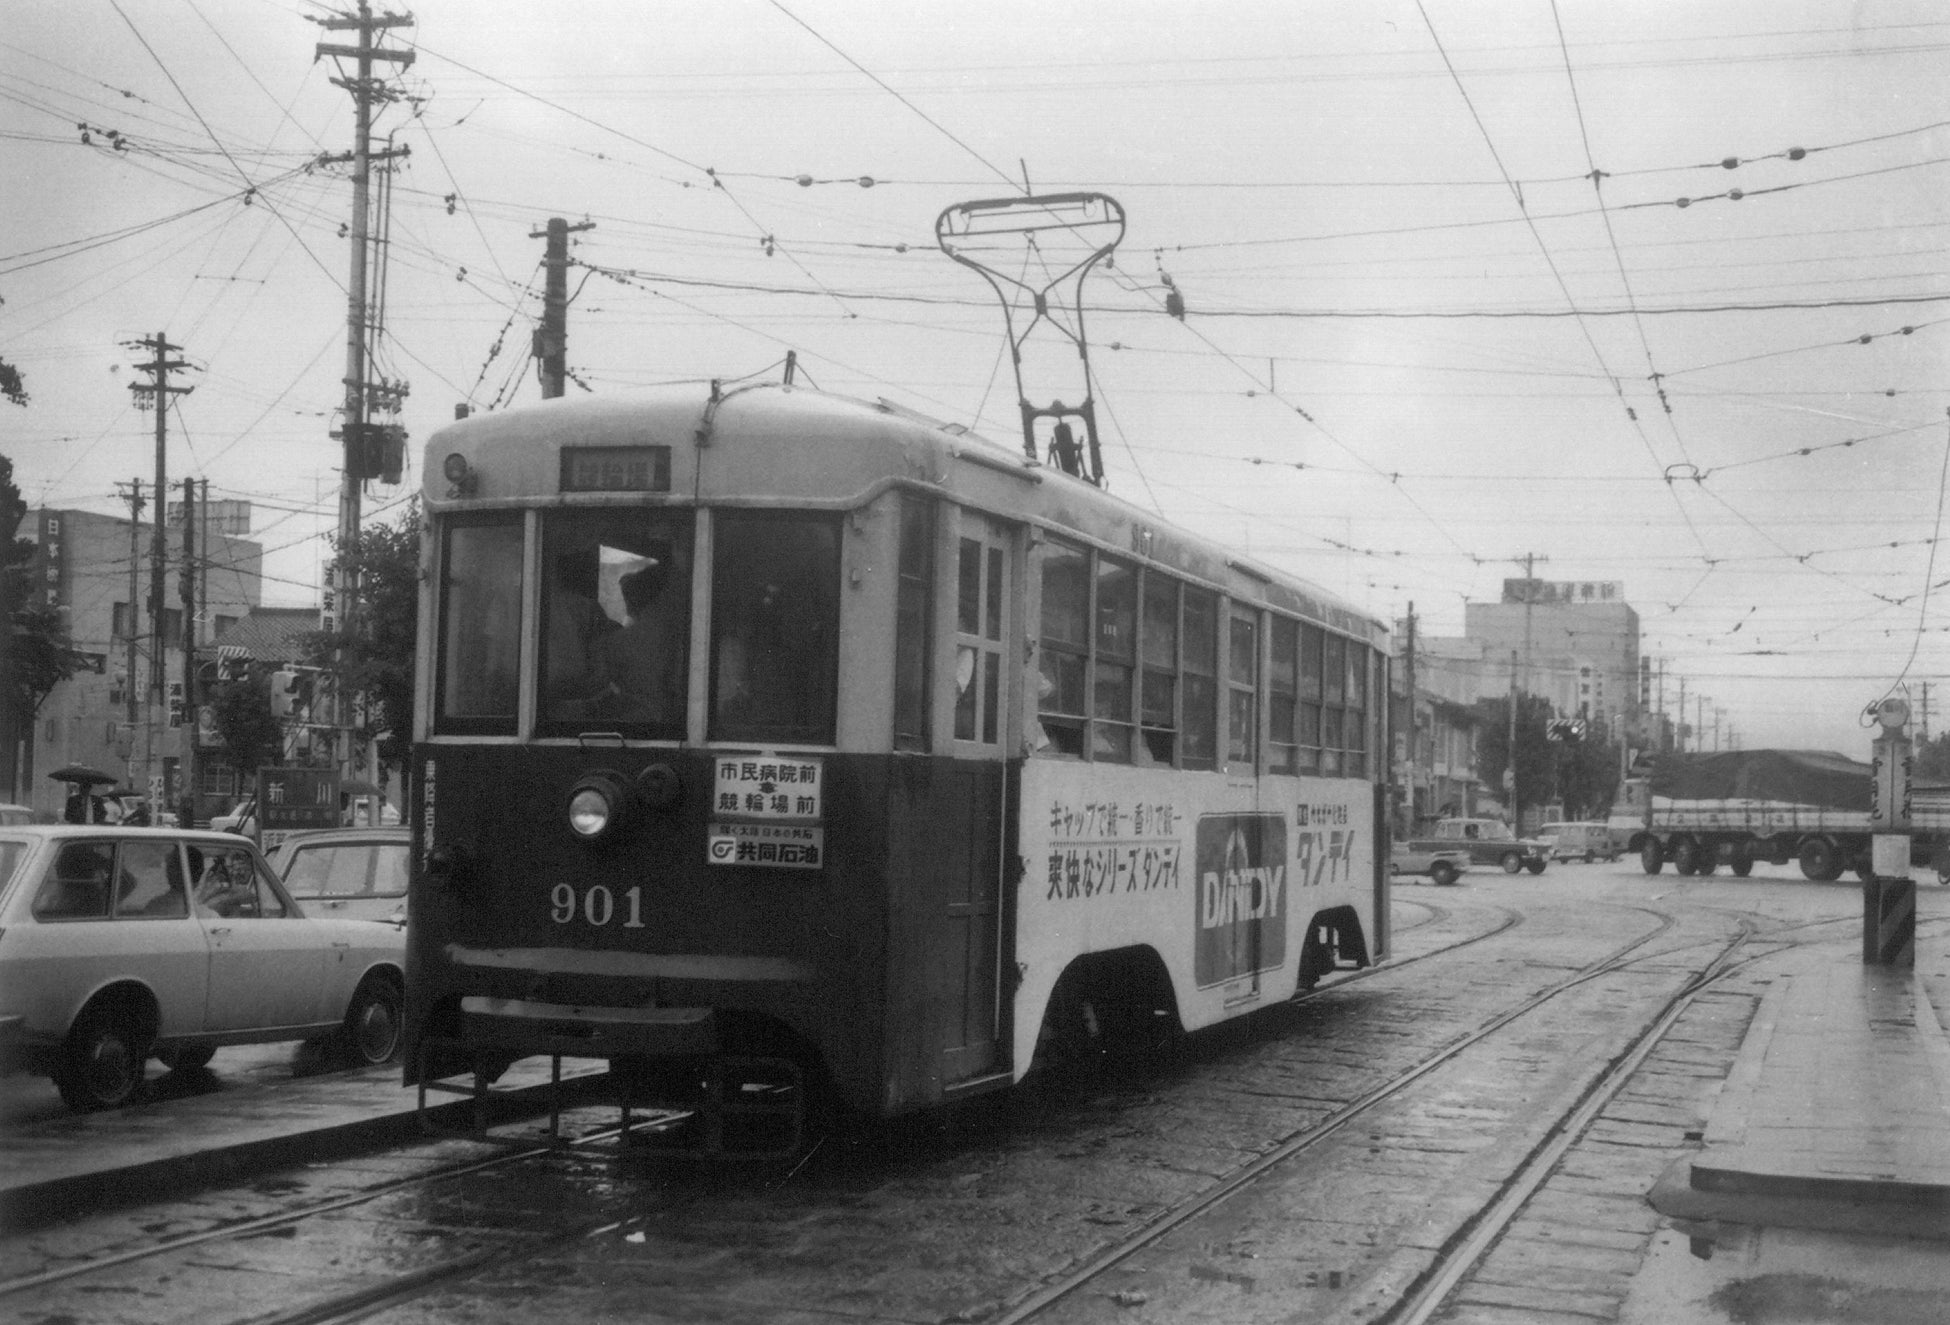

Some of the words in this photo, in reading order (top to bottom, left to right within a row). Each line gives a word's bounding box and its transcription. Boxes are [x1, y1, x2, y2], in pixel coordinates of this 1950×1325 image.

[720, 762, 816, 784] 市民病院前
[718, 793, 816, 815] 競輪場前
[737, 841, 819, 865] 共同石油
[551, 883, 645, 928] 901
[1202, 865, 1284, 929] DANDY
